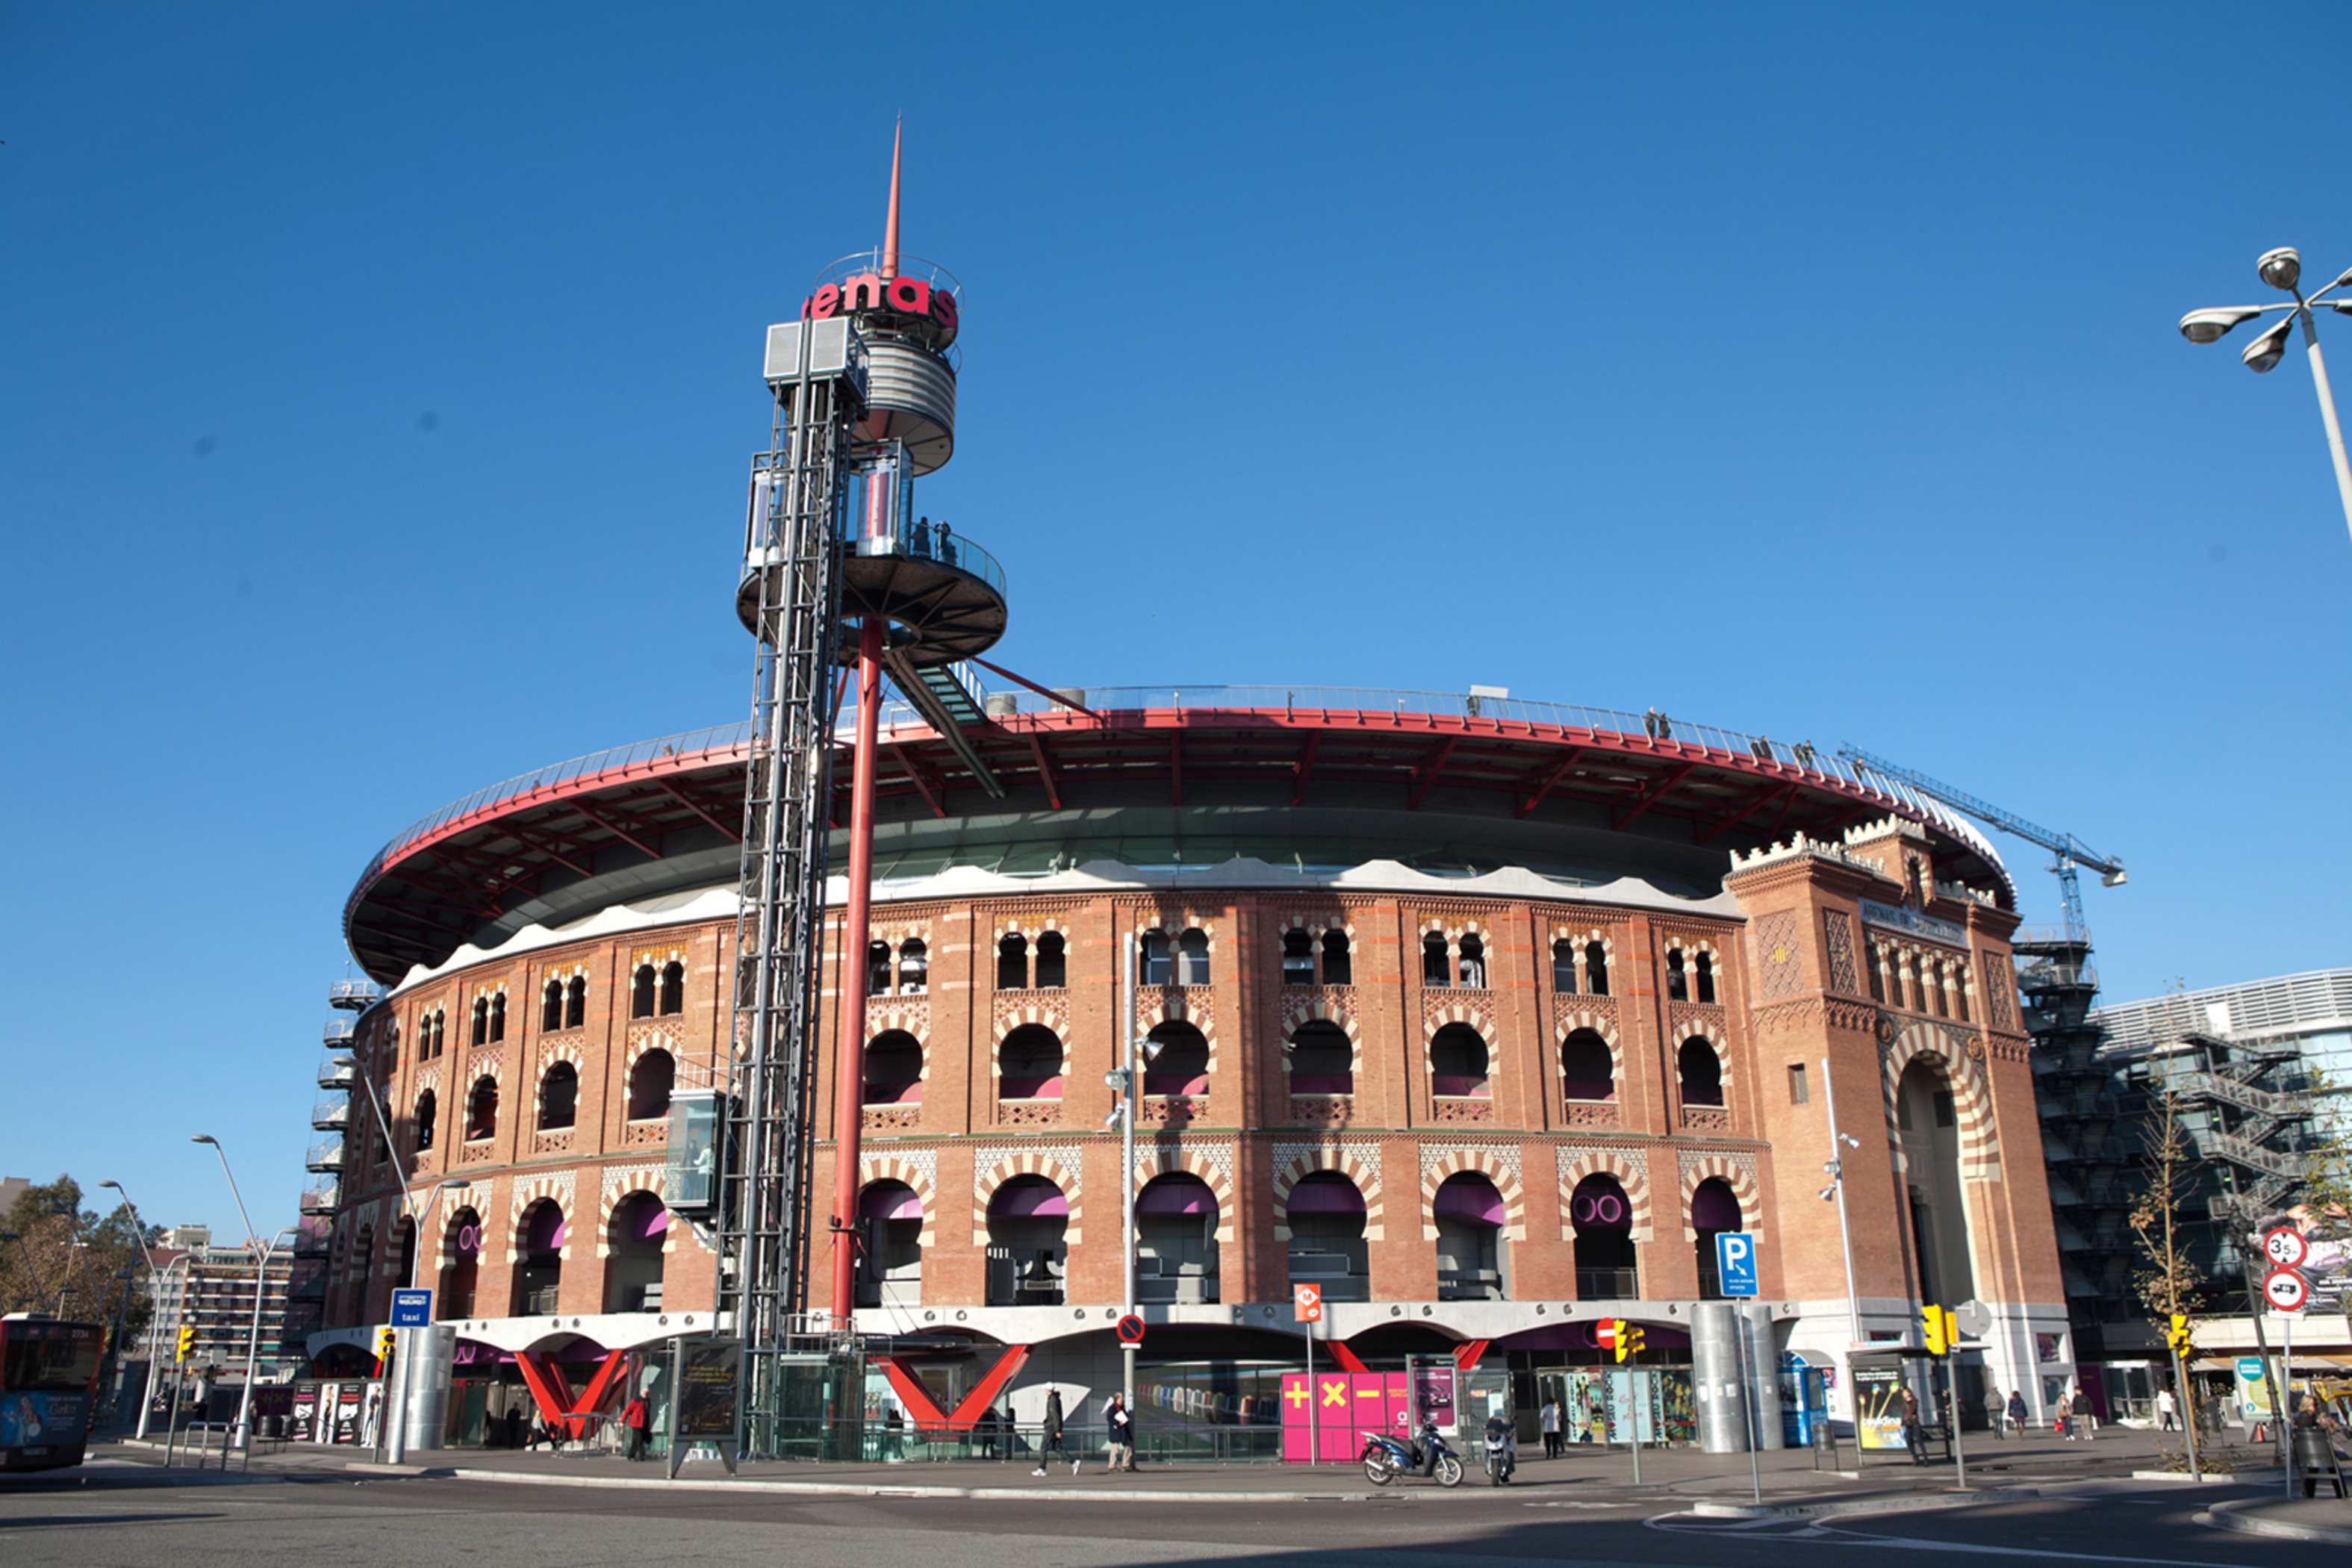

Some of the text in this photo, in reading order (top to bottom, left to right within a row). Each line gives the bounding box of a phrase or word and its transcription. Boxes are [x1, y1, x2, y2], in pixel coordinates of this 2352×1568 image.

[1725, 1238, 1747, 1270] P
[1302, 1293, 1313, 1301] M
[402, 1313, 420, 1322] taxi
[72, 1329, 89, 1339] 2734
